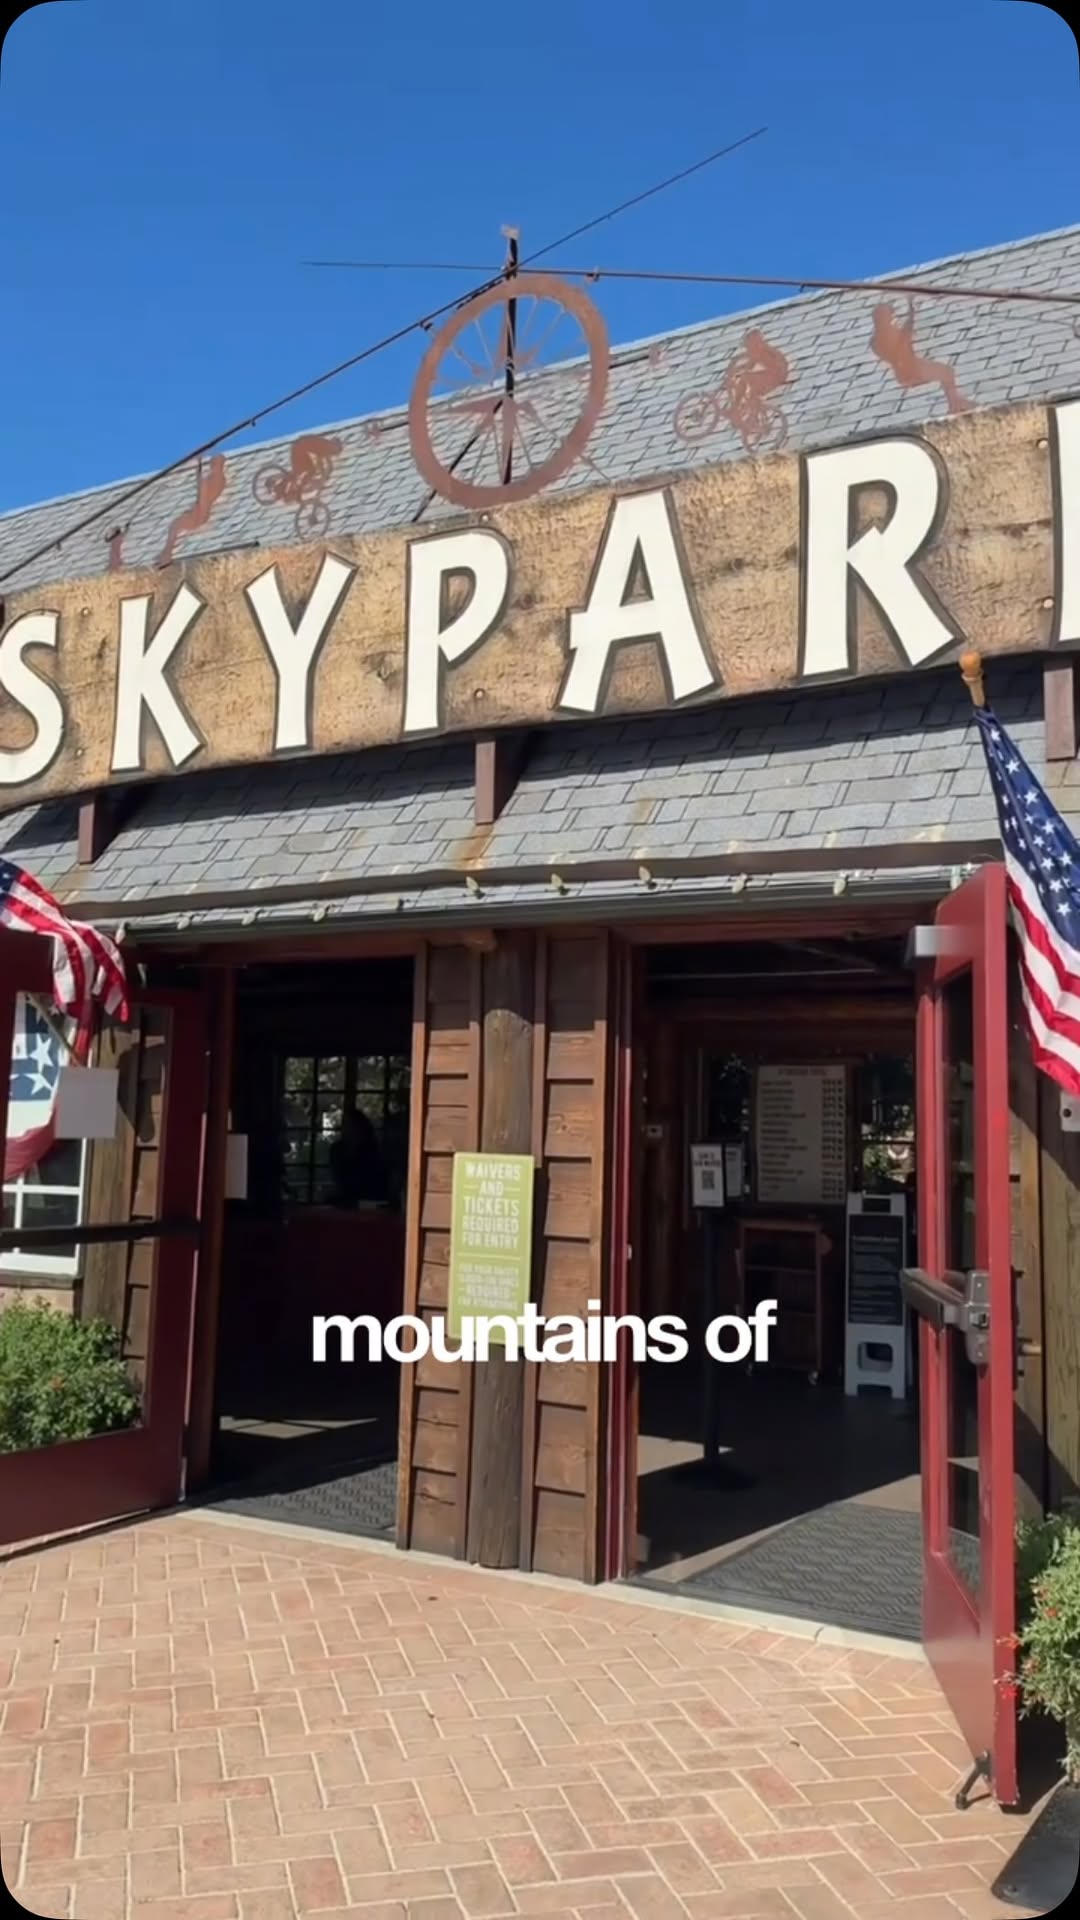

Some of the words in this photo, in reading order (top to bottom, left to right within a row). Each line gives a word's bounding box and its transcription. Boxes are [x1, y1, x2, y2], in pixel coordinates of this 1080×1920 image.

[464, 1161, 521, 1181] WAIVERS
[479, 1181, 504, 1197] AND
[463, 1197, 520, 1216] TICKETS
[462, 1215, 519, 1234] REQUIRED
[462, 1232, 481, 1247] FOR
[484, 1233, 519, 1249] ENTRY
